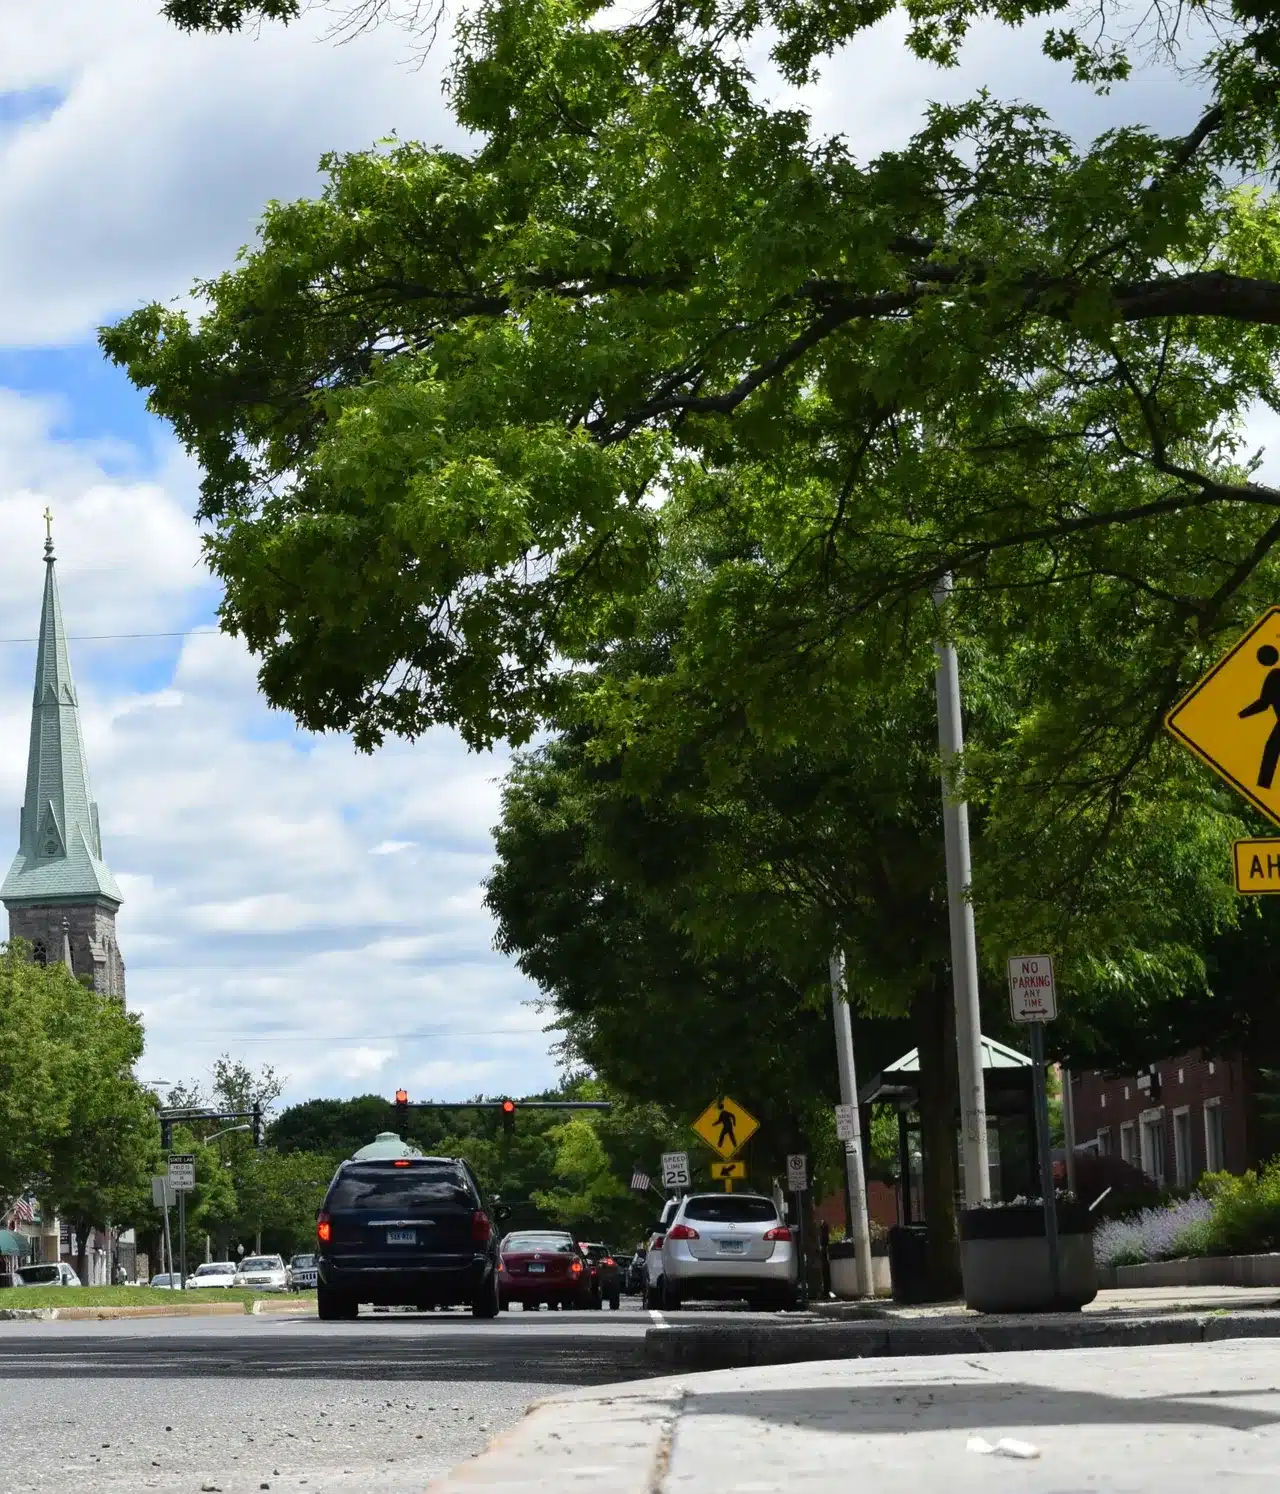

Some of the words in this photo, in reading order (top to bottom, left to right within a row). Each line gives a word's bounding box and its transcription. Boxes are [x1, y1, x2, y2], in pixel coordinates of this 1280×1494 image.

[1022, 962, 1038, 974] NO
[1012, 975, 1050, 989] PARKING
[1024, 989, 1040, 998] ANY
[1024, 999, 1042, 1007] TIME
[666, 1170, 687, 1184] 25
